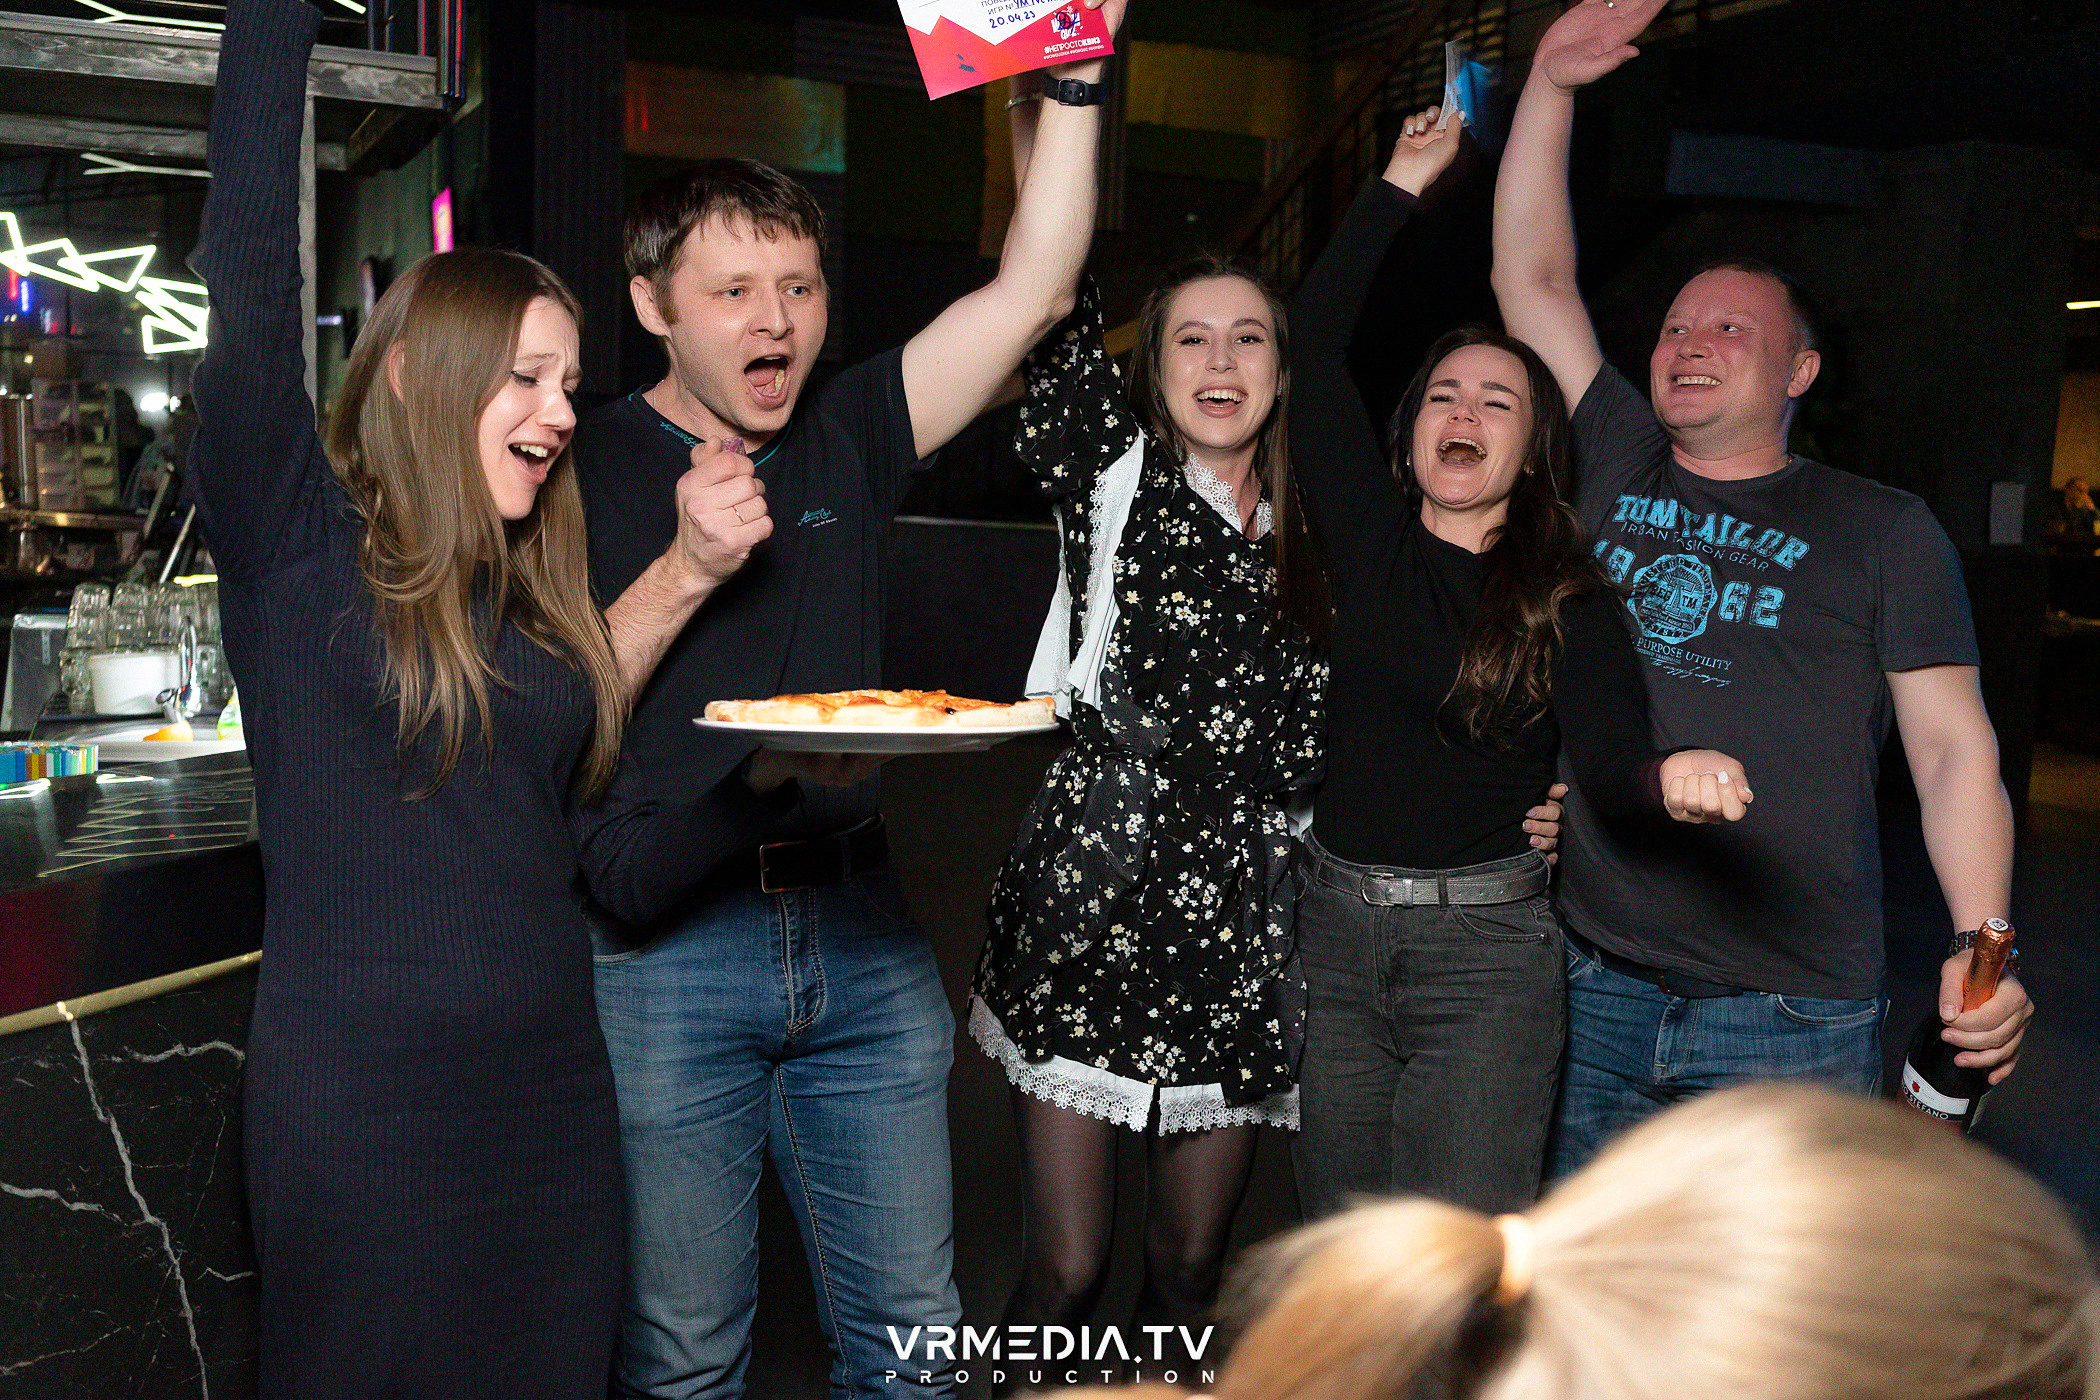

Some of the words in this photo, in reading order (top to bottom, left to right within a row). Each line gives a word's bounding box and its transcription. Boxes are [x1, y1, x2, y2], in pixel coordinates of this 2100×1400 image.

[1729, 551, 1769, 572] GEAR
[1718, 580, 1786, 629] 62
[1637, 637, 1683, 659] PURPOSE
[1685, 651, 1732, 670] UTILITY
[1909, 1094, 1949, 1120] STEFANO
